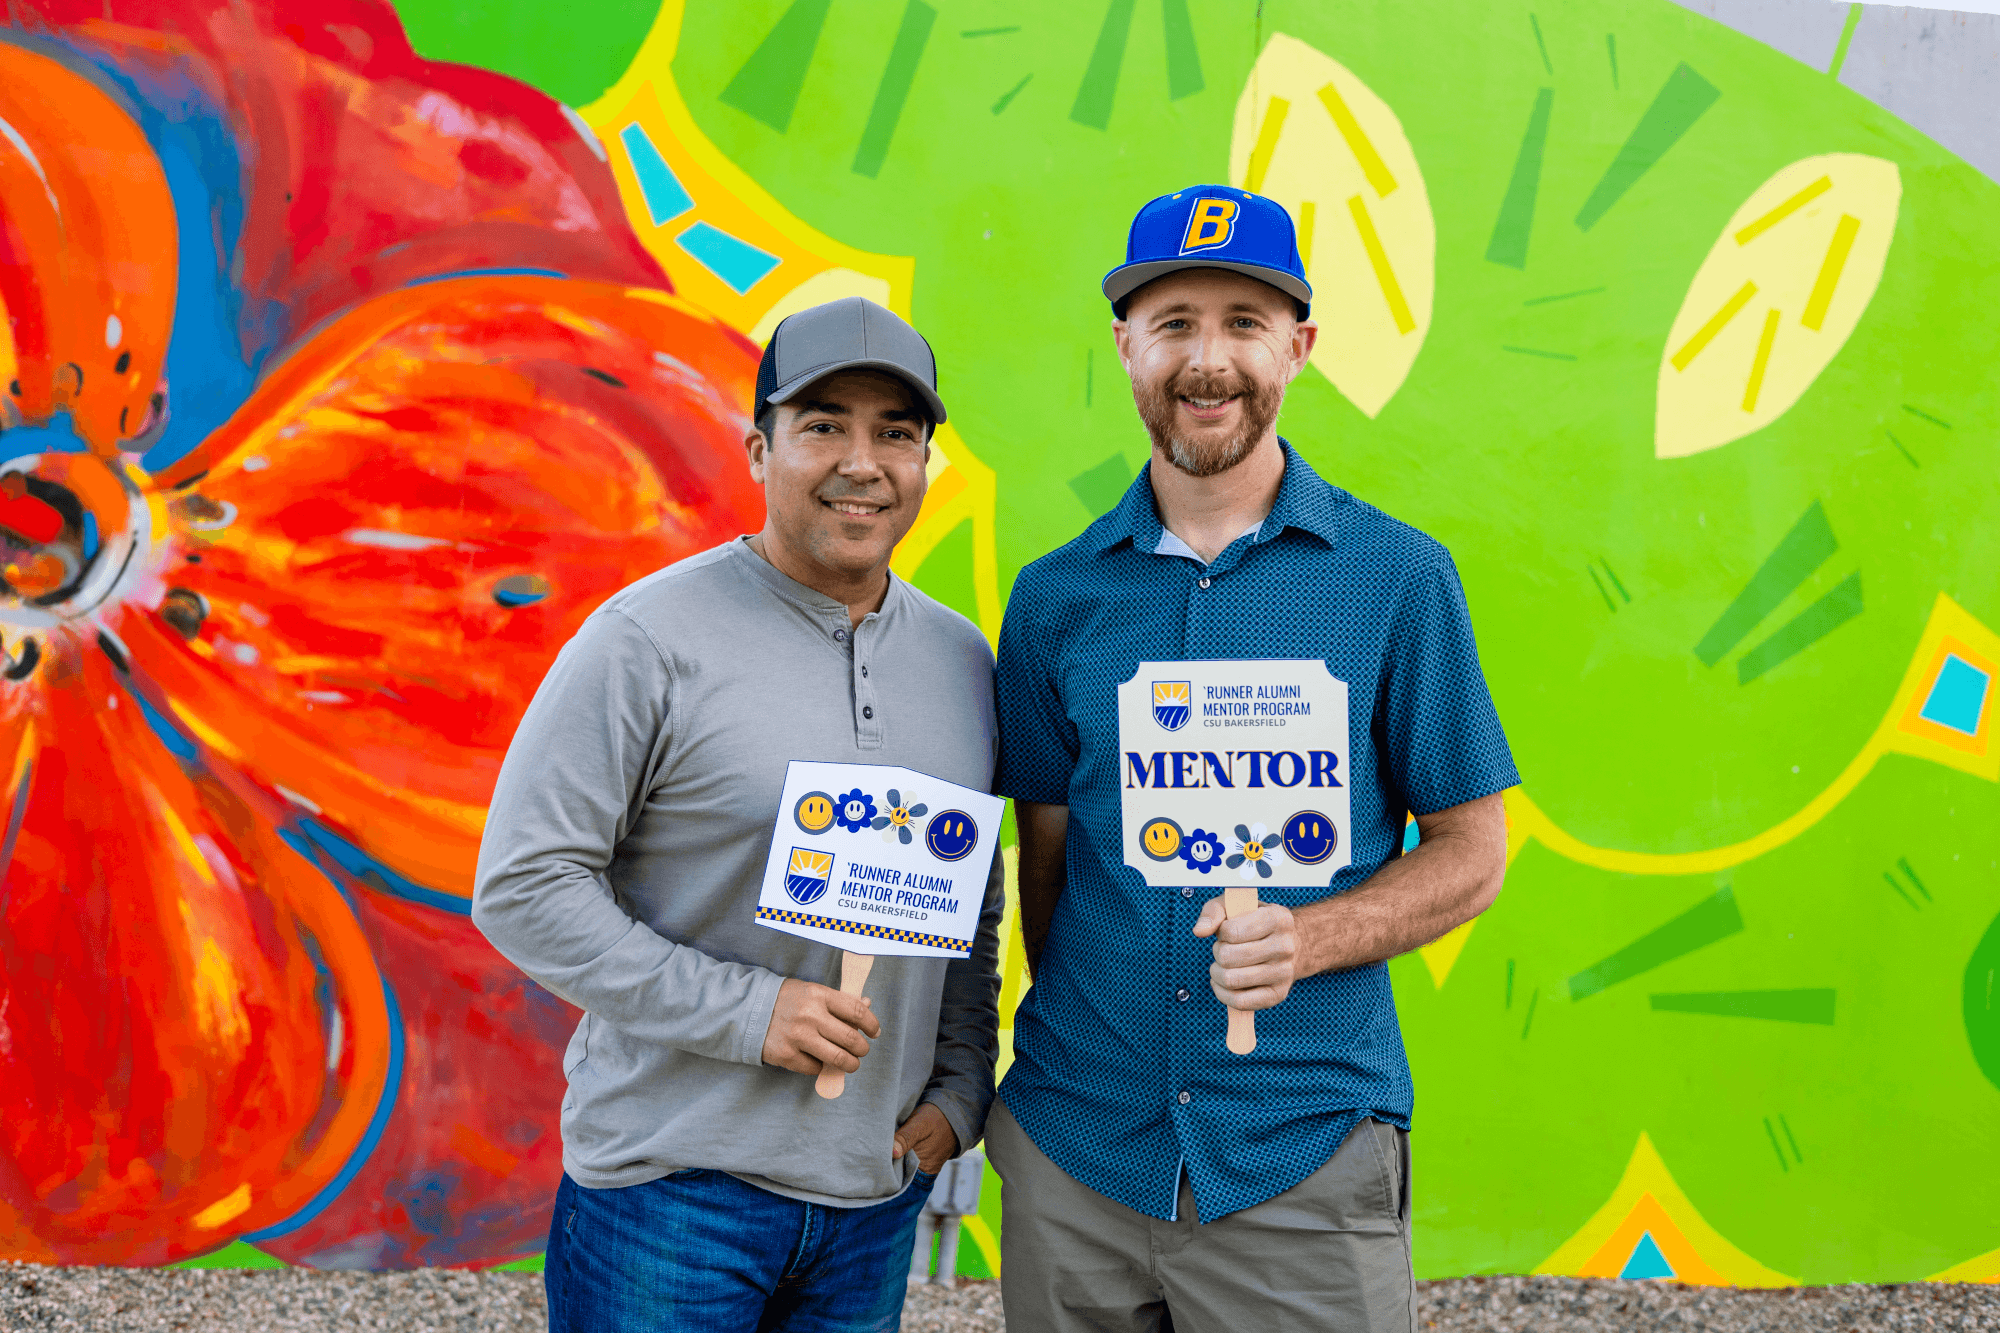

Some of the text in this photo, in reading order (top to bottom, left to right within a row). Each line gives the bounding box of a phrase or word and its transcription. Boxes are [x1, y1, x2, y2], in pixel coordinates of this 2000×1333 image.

[1179, 197, 1240, 256] B
[1257, 685, 1301, 699] ALUMNI
[1203, 702, 1311, 717] MENTOR PROGRAM
[1203, 718, 1287, 728] CSU BAKERSFIELD
[1124, 750, 1344, 789] MENTOR
[903, 872, 953, 894] ALUMNI
[840, 880, 959, 914] MENTOR PROGRAM
[837, 898, 928, 921] CSU BAKERSFIELD
